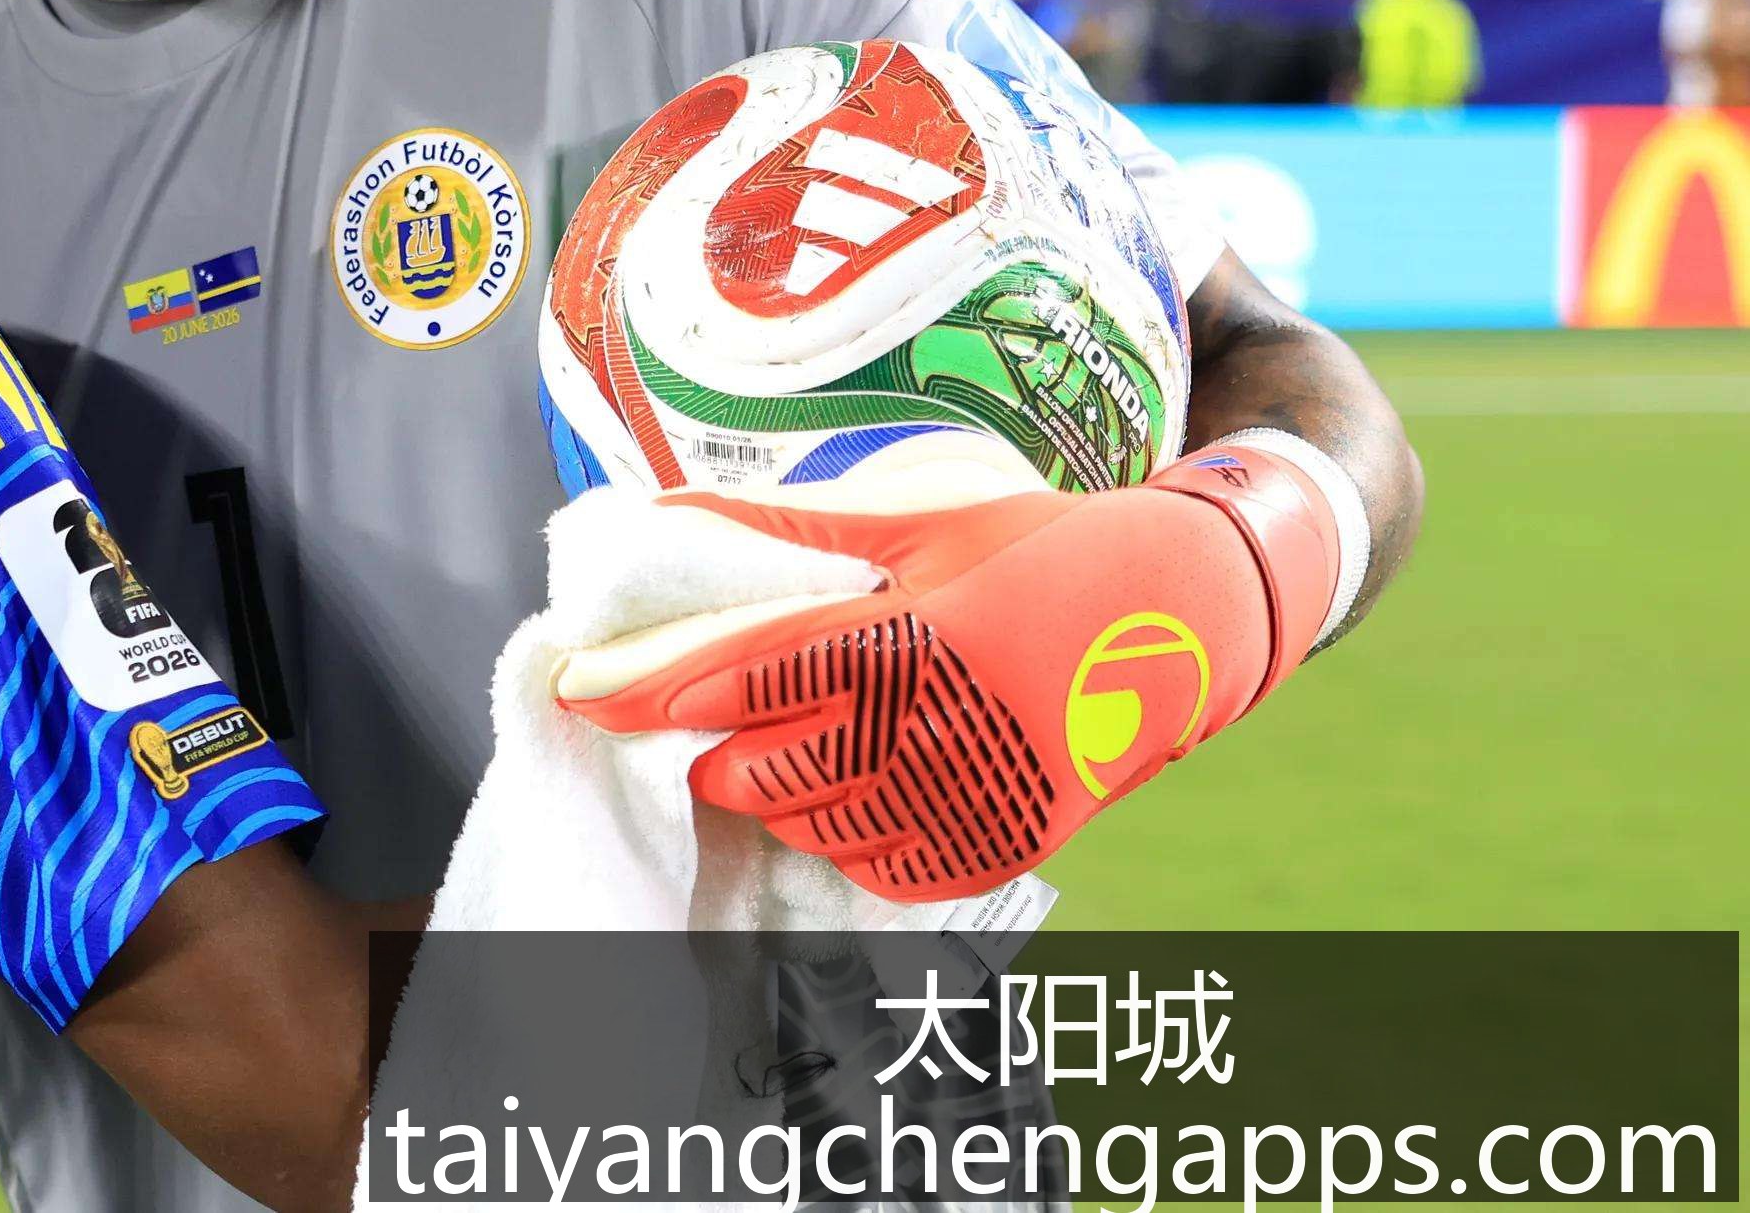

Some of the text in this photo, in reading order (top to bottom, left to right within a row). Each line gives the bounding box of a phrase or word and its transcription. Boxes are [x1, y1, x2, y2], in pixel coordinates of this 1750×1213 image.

[342, 140, 518, 326] Federashon Futbòl Kòrsou
[162, 306, 242, 345] 20 JUNE 2026
[1021, 404, 1054, 438] BALLON
[1050, 435, 1063, 449] DE
[1060, 445, 1083, 477] MATCH
[1048, 416, 1080, 453] OFFICIAL
[1076, 449, 1098, 480] MATCH
[1061, 413, 1087, 446] OFICIAL
[1084, 441, 1097, 460] DEL
[1095, 456, 1114, 488] PARTIDO
[1127, 430, 1142, 454] PRO
[124, 601, 162, 625] FIFA
[118, 636, 170, 661] WORLD
[127, 647, 201, 684] 2026
[171, 712, 247, 756] DEBUT
[184, 730, 250, 764] FIFA WORLD CUP
